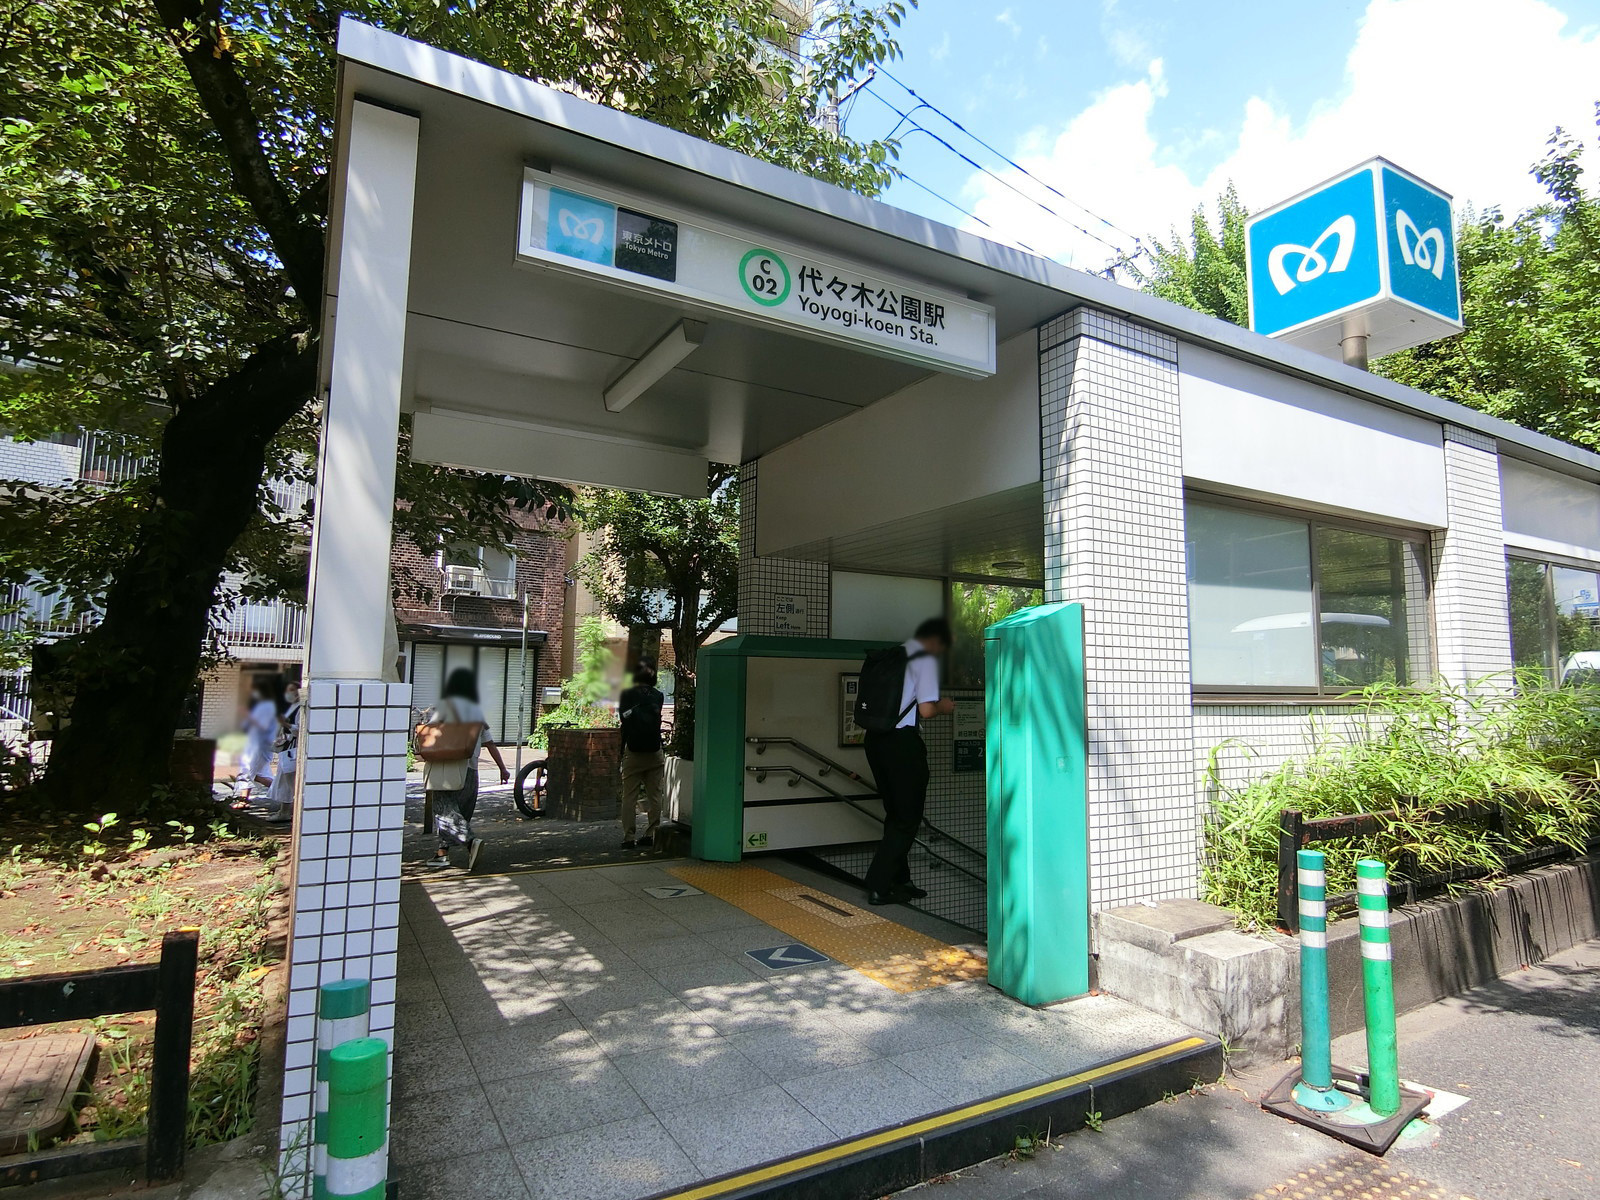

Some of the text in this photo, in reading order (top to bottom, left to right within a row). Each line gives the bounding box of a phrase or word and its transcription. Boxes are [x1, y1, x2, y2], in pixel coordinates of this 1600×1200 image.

[622, 230, 672, 252] 東京メトロ
[625, 242, 669, 260] Tokyo Metro
[760, 259, 771, 275] C
[752, 275, 777, 295] 02
[798, 265, 945, 330] 代々木公園駅
[798, 295, 938, 346] Yoyogi-koen Sta.
